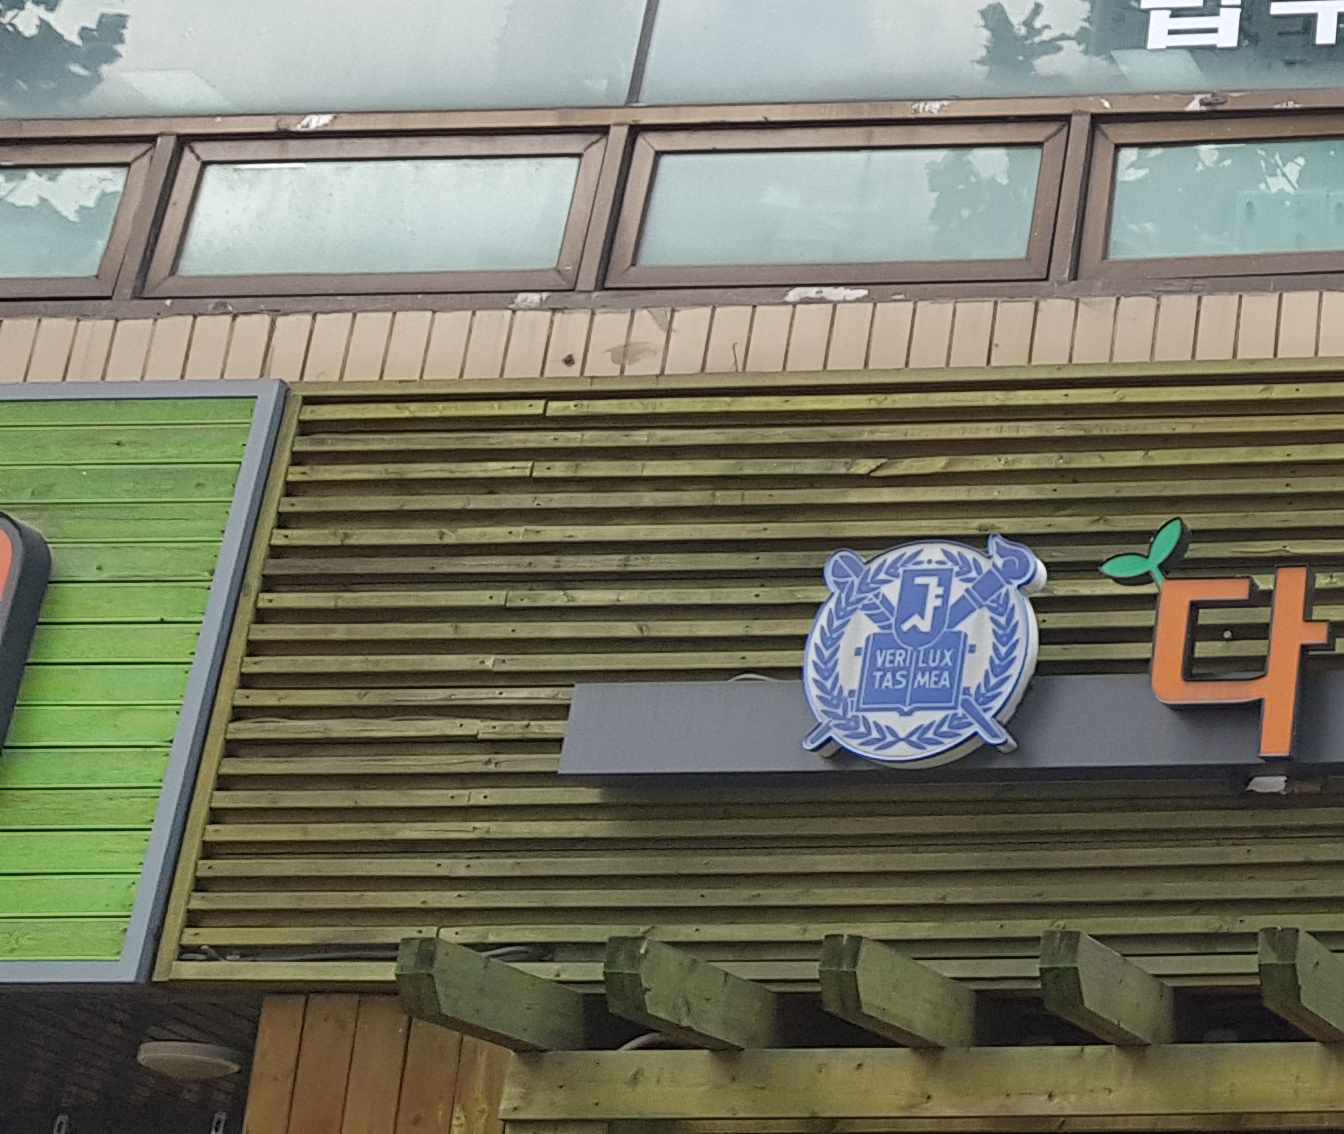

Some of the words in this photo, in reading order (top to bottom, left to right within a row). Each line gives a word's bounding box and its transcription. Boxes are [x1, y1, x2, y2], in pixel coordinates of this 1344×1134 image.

[917, 648, 953, 667] LUX
[872, 670, 906, 690] TAS
[912, 670, 951, 690] MEA
